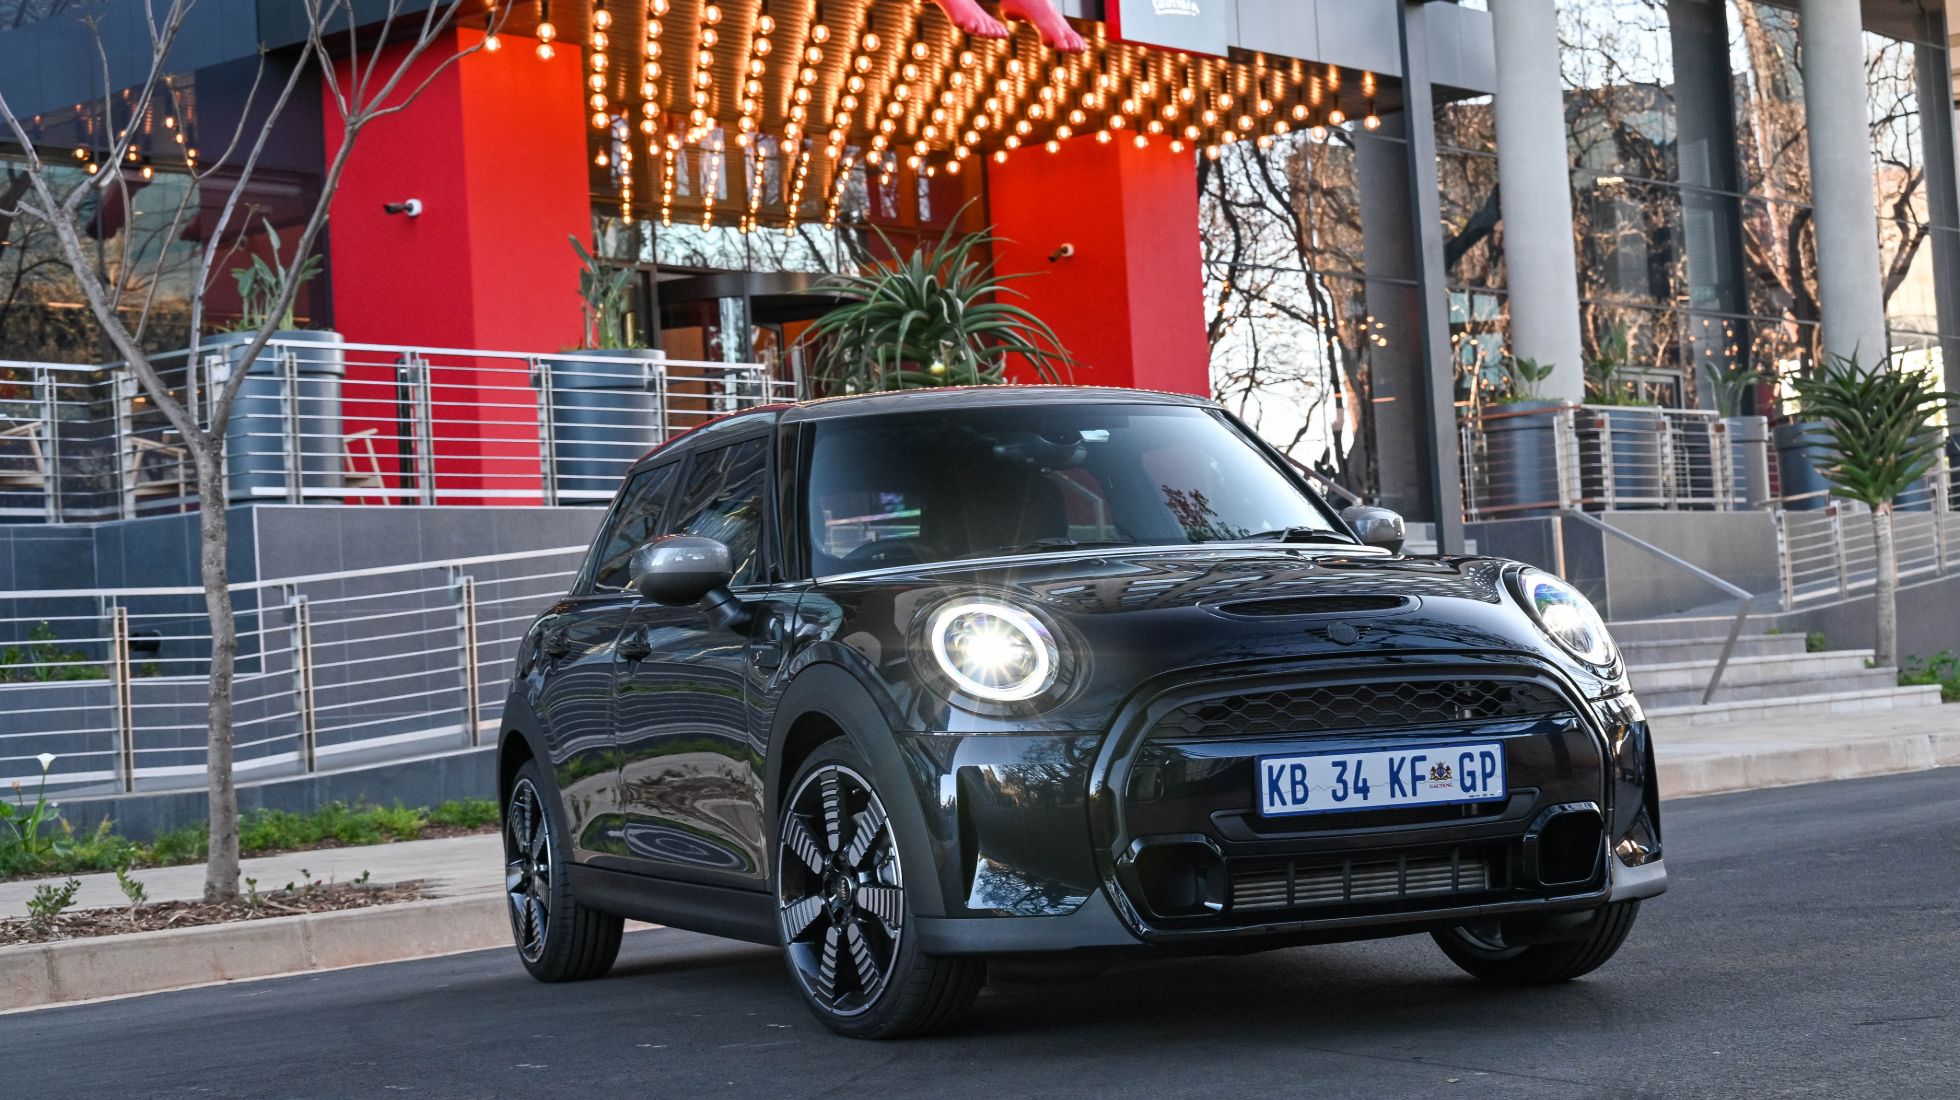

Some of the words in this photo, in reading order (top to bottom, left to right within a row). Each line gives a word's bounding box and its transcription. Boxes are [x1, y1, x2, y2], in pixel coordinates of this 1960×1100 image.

[1268, 763, 1309, 807] KB
[1331, 760, 1370, 802] 34
[1388, 755, 1427, 799] KF
[1458, 751, 1496, 793] GP
